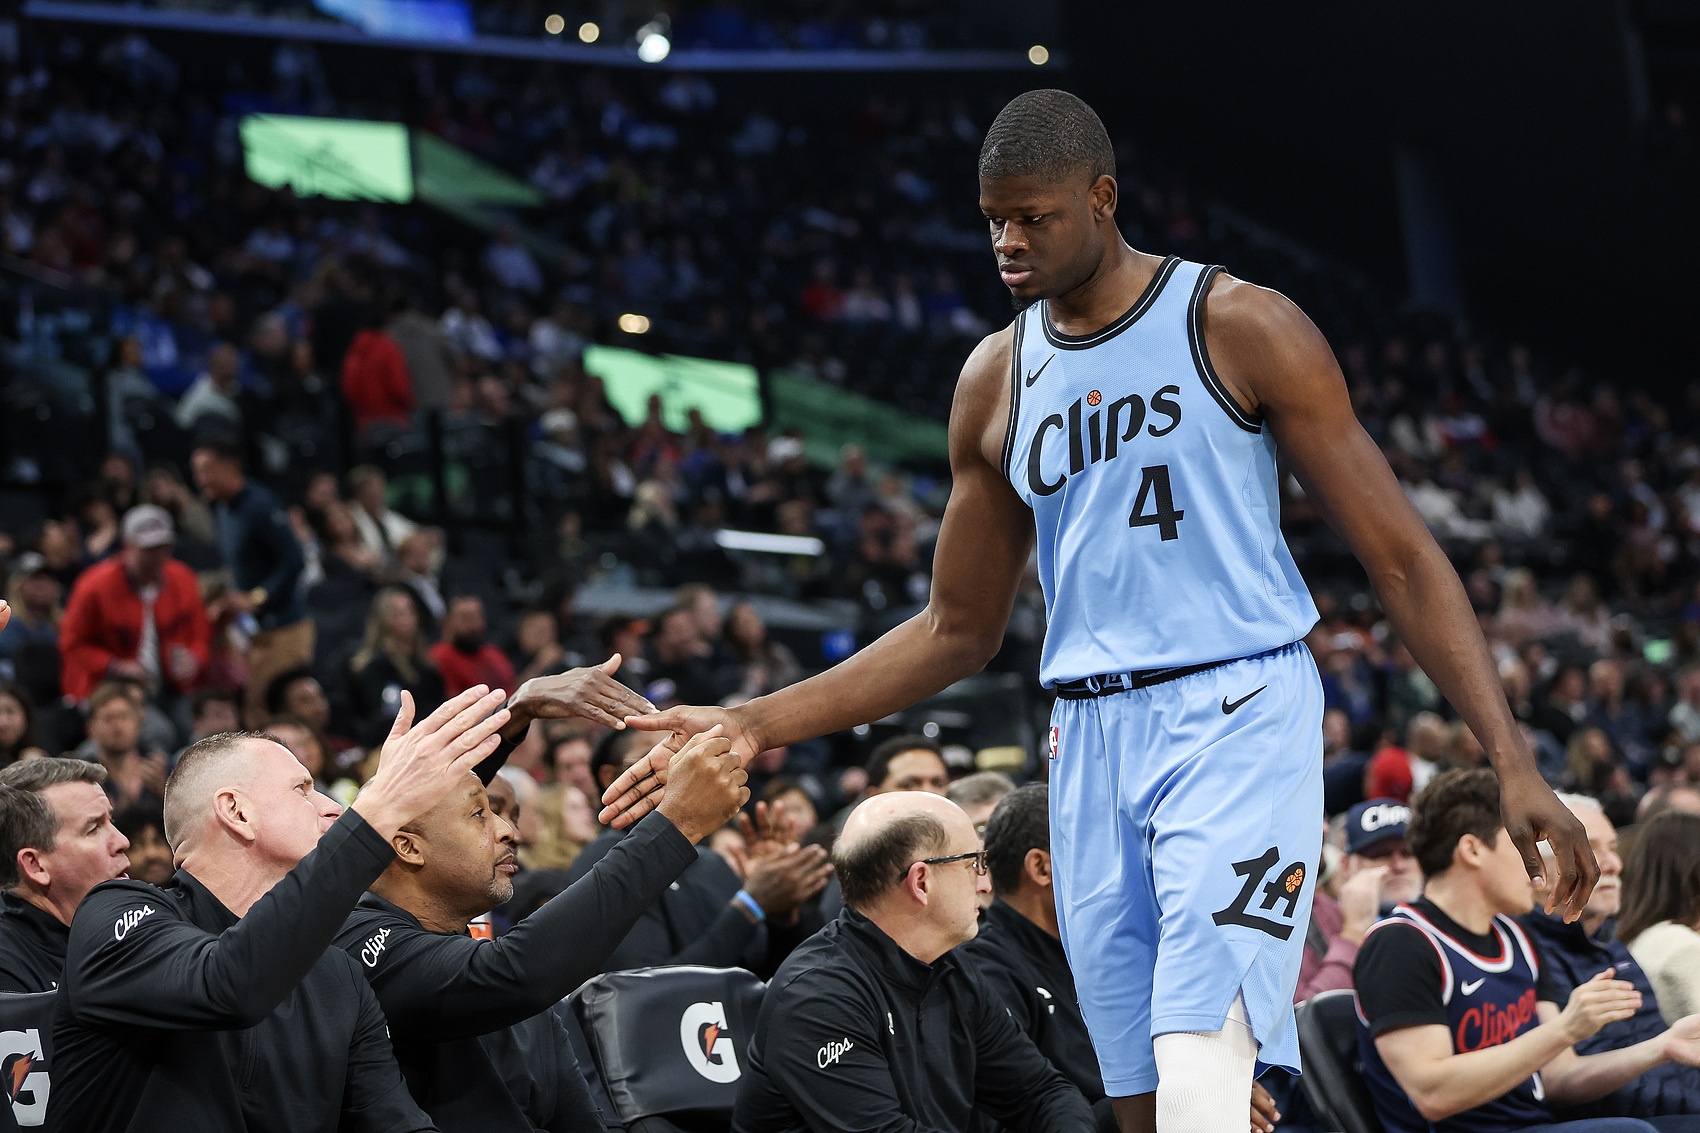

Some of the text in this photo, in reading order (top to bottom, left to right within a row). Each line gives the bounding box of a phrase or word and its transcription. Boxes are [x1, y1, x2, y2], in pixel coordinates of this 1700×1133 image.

[1027, 385, 1182, 497] Clips
[1129, 464, 1185, 541] 4
[114, 905, 156, 941] Clips
[1211, 846, 1306, 941] LA
[361, 927, 392, 968] Clips
[680, 1001, 742, 1084] G
[817, 1037, 854, 1069] Clips
[1456, 988, 1537, 1054] Clipper
[0, 1028, 51, 1127] G
